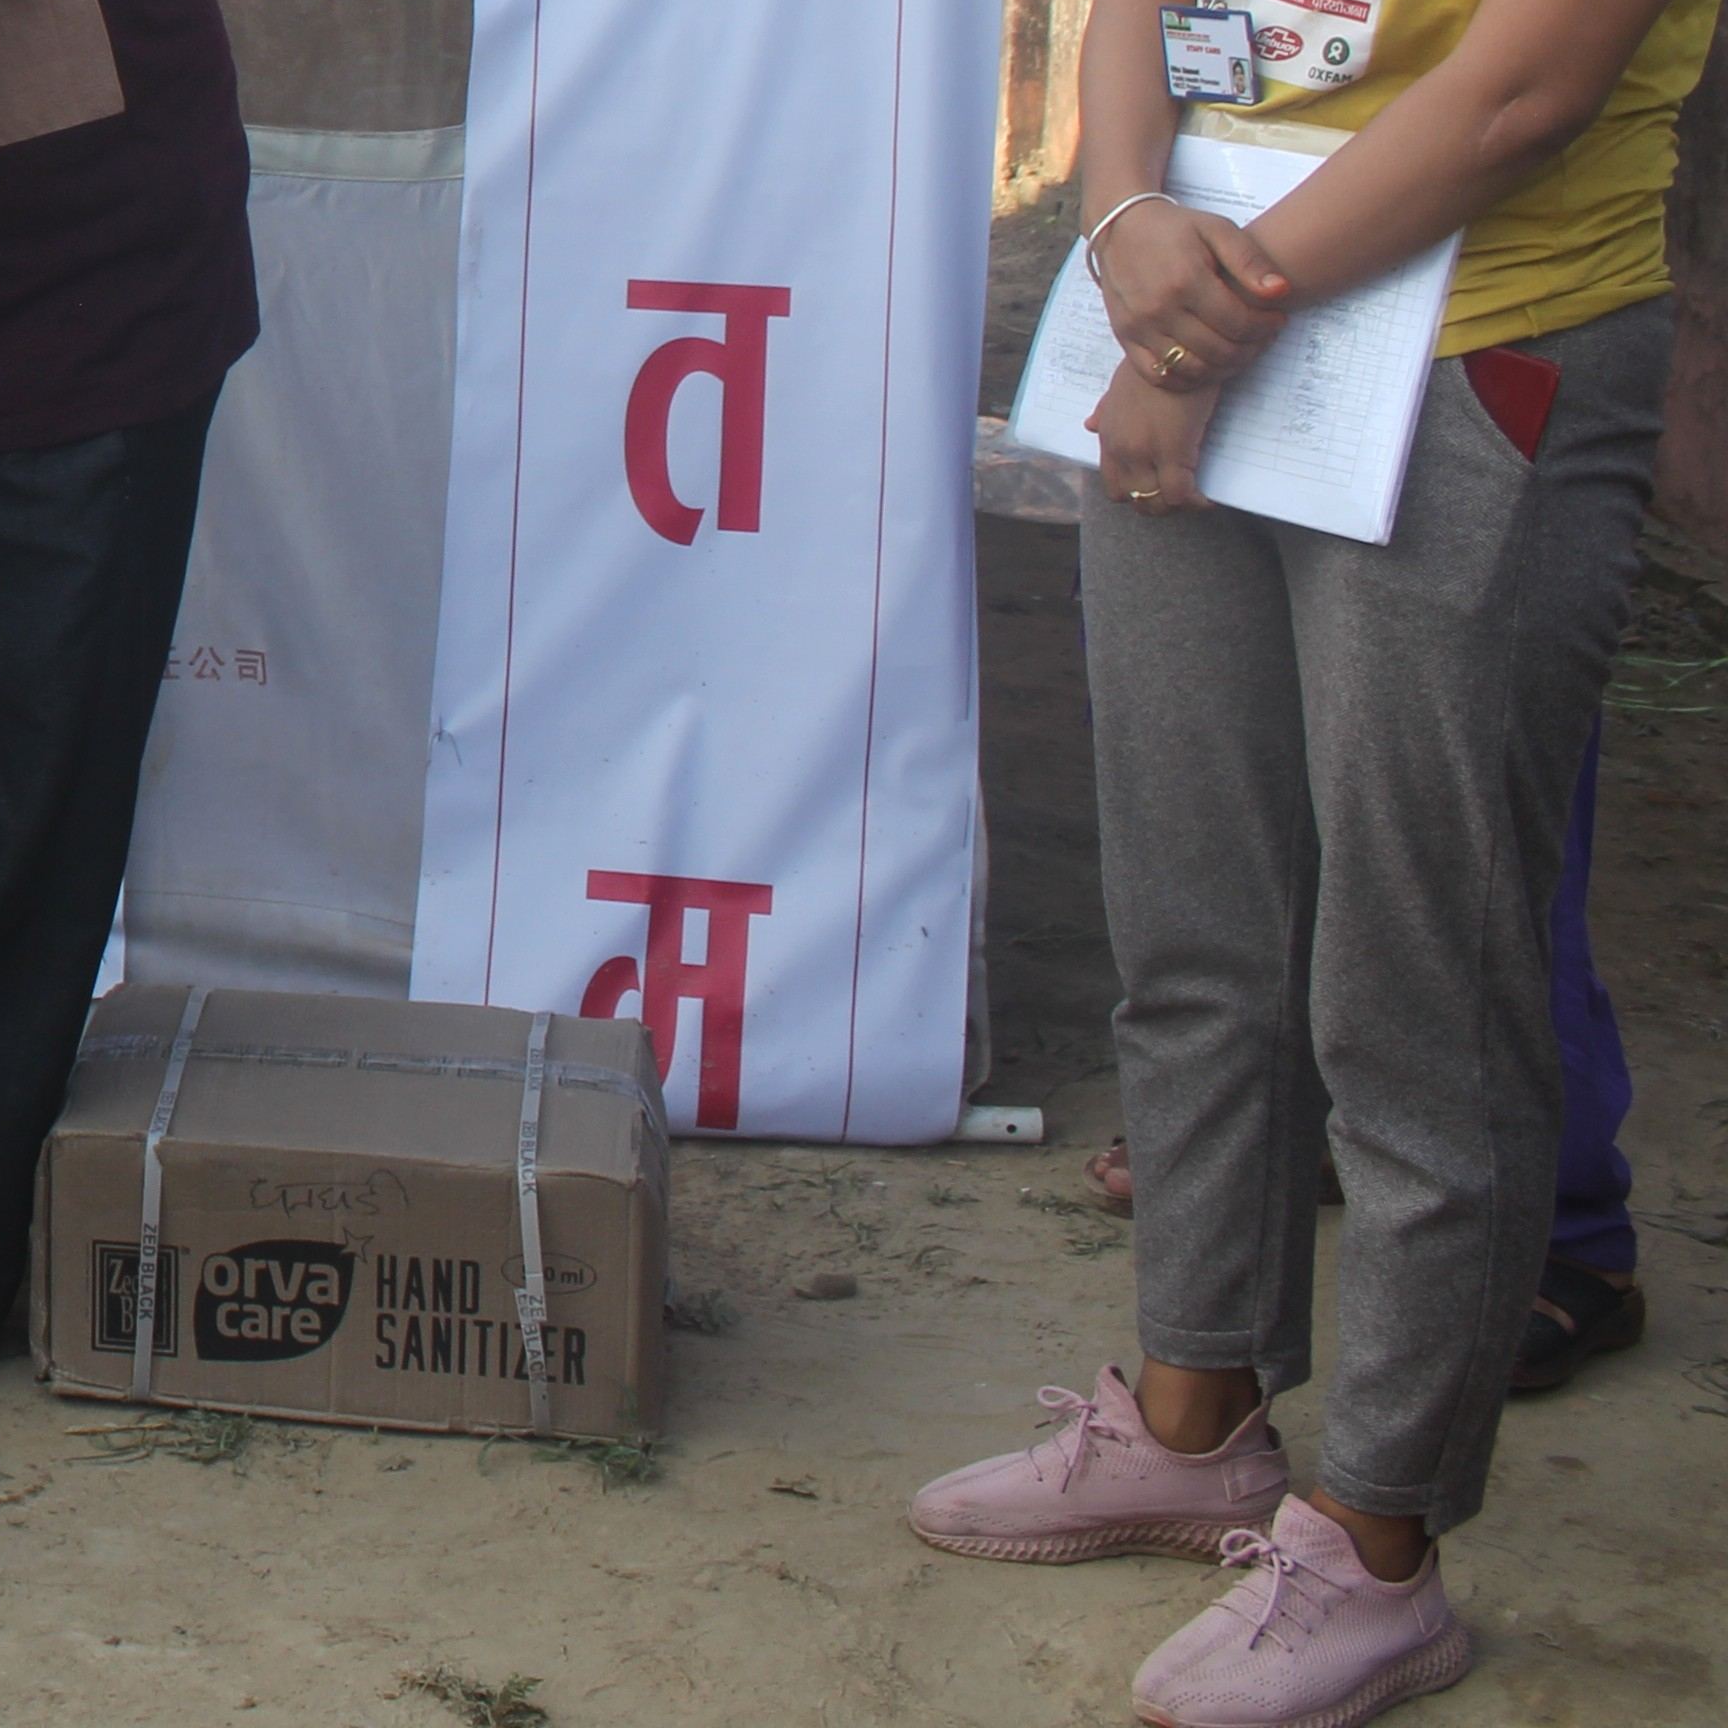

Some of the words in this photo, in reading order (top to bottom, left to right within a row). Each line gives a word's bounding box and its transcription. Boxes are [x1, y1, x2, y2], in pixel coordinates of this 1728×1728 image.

[144, 1224, 157, 1258] ZED
[138, 1264, 155, 1321] BLACK
[203, 1251, 340, 1306] orva
[375, 1253, 481, 1316] HAND
[215, 1301, 322, 1346] care
